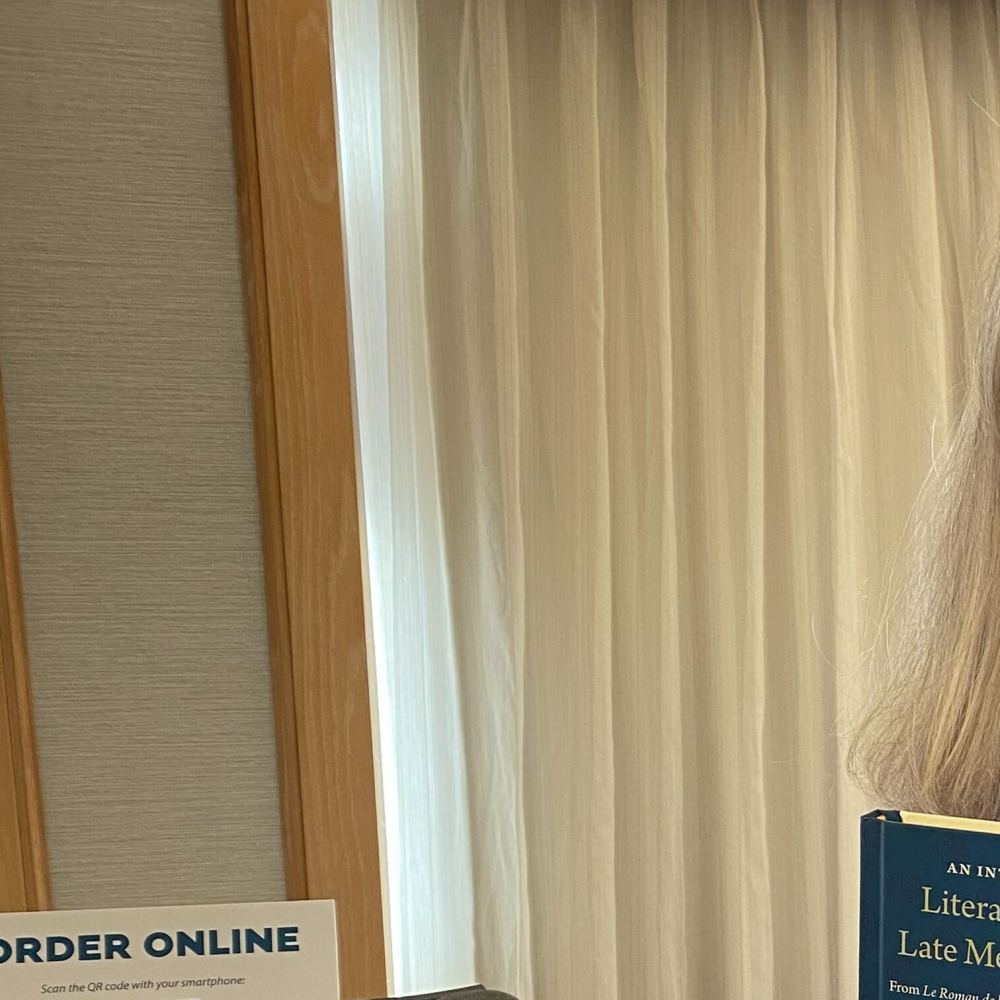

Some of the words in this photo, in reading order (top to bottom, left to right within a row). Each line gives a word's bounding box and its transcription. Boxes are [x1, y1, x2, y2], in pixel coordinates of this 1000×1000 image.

[946, 862, 970, 876] AN
[144, 926, 300, 958] ONLINE
[897, 929, 958, 962] Late
[41, 984, 66, 994] Scan
[68, 983, 85, 993] the
[87, 981, 103, 992] QR
[105, 980, 130, 991] code
[131, 978, 154, 990] with
[155, 978, 179, 992] your
[180, 975, 246, 989] smartphone:
[889, 980, 920, 996] From
[923, 985, 937, 998] Le
